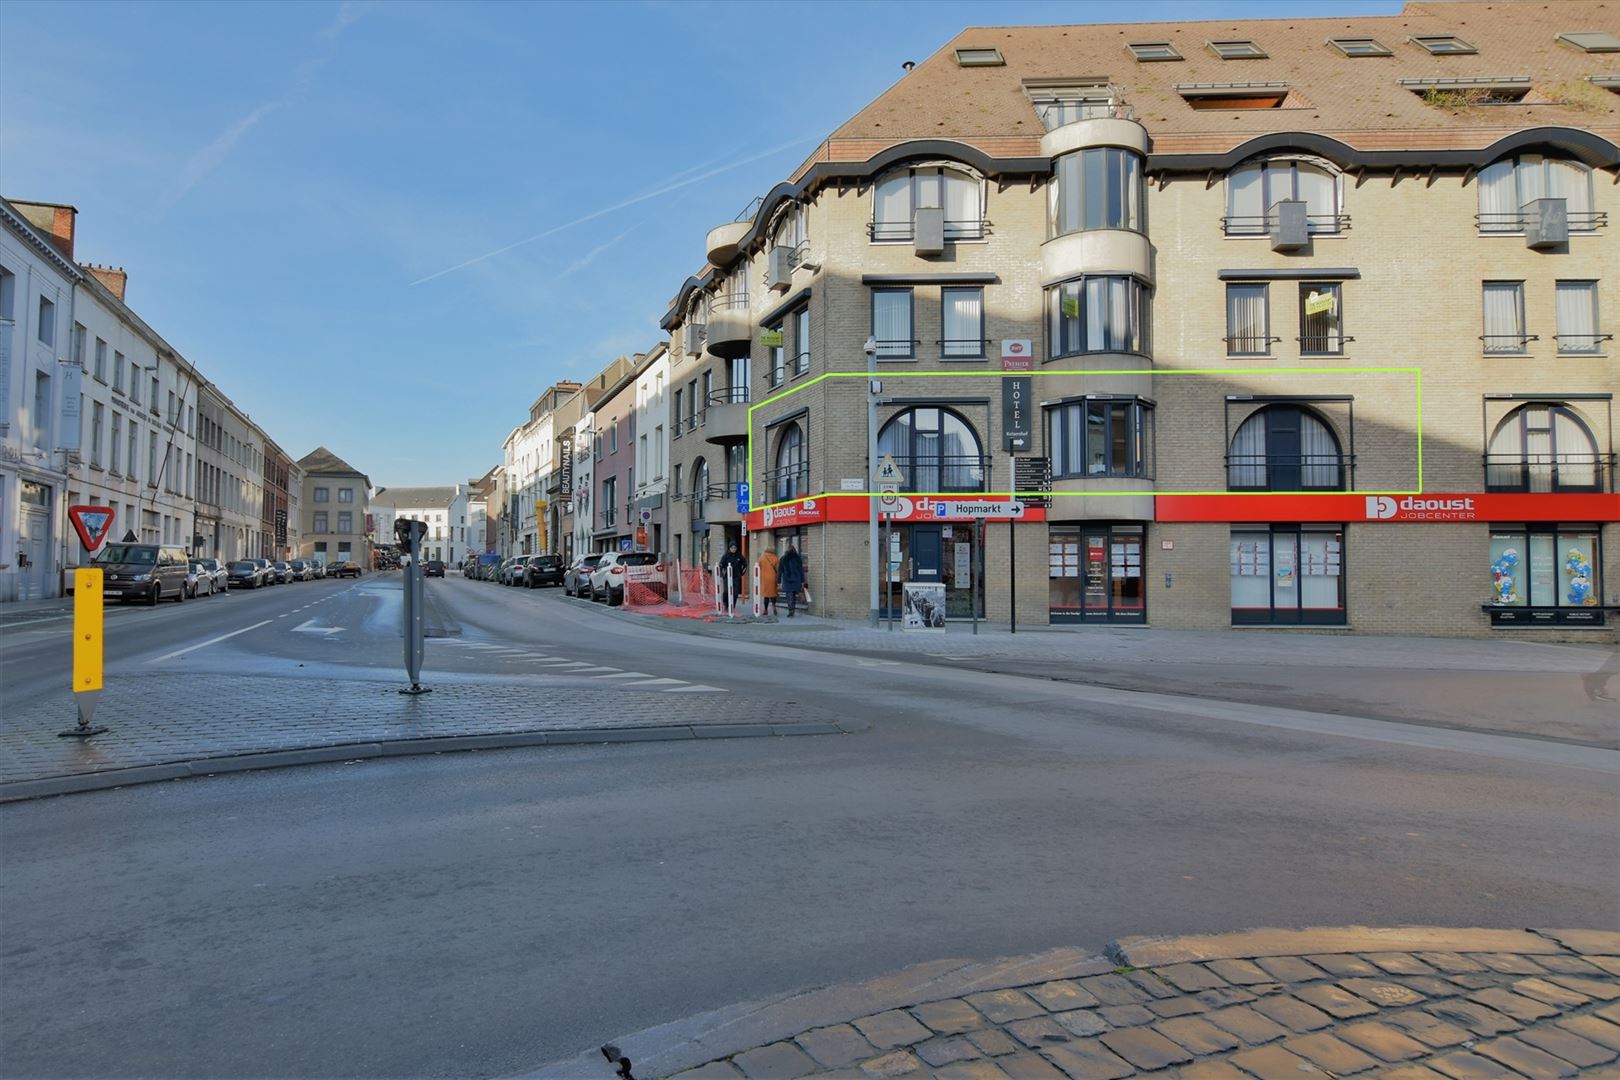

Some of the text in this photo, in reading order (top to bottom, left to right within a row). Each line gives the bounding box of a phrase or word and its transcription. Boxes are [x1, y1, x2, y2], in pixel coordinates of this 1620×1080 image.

[562, 440, 571, 494] BEAUTYNAILS
[740, 484, 749, 496] P
[956, 504, 1001, 514] Hopmarkt
[1400, 496, 1475, 511] daoust
